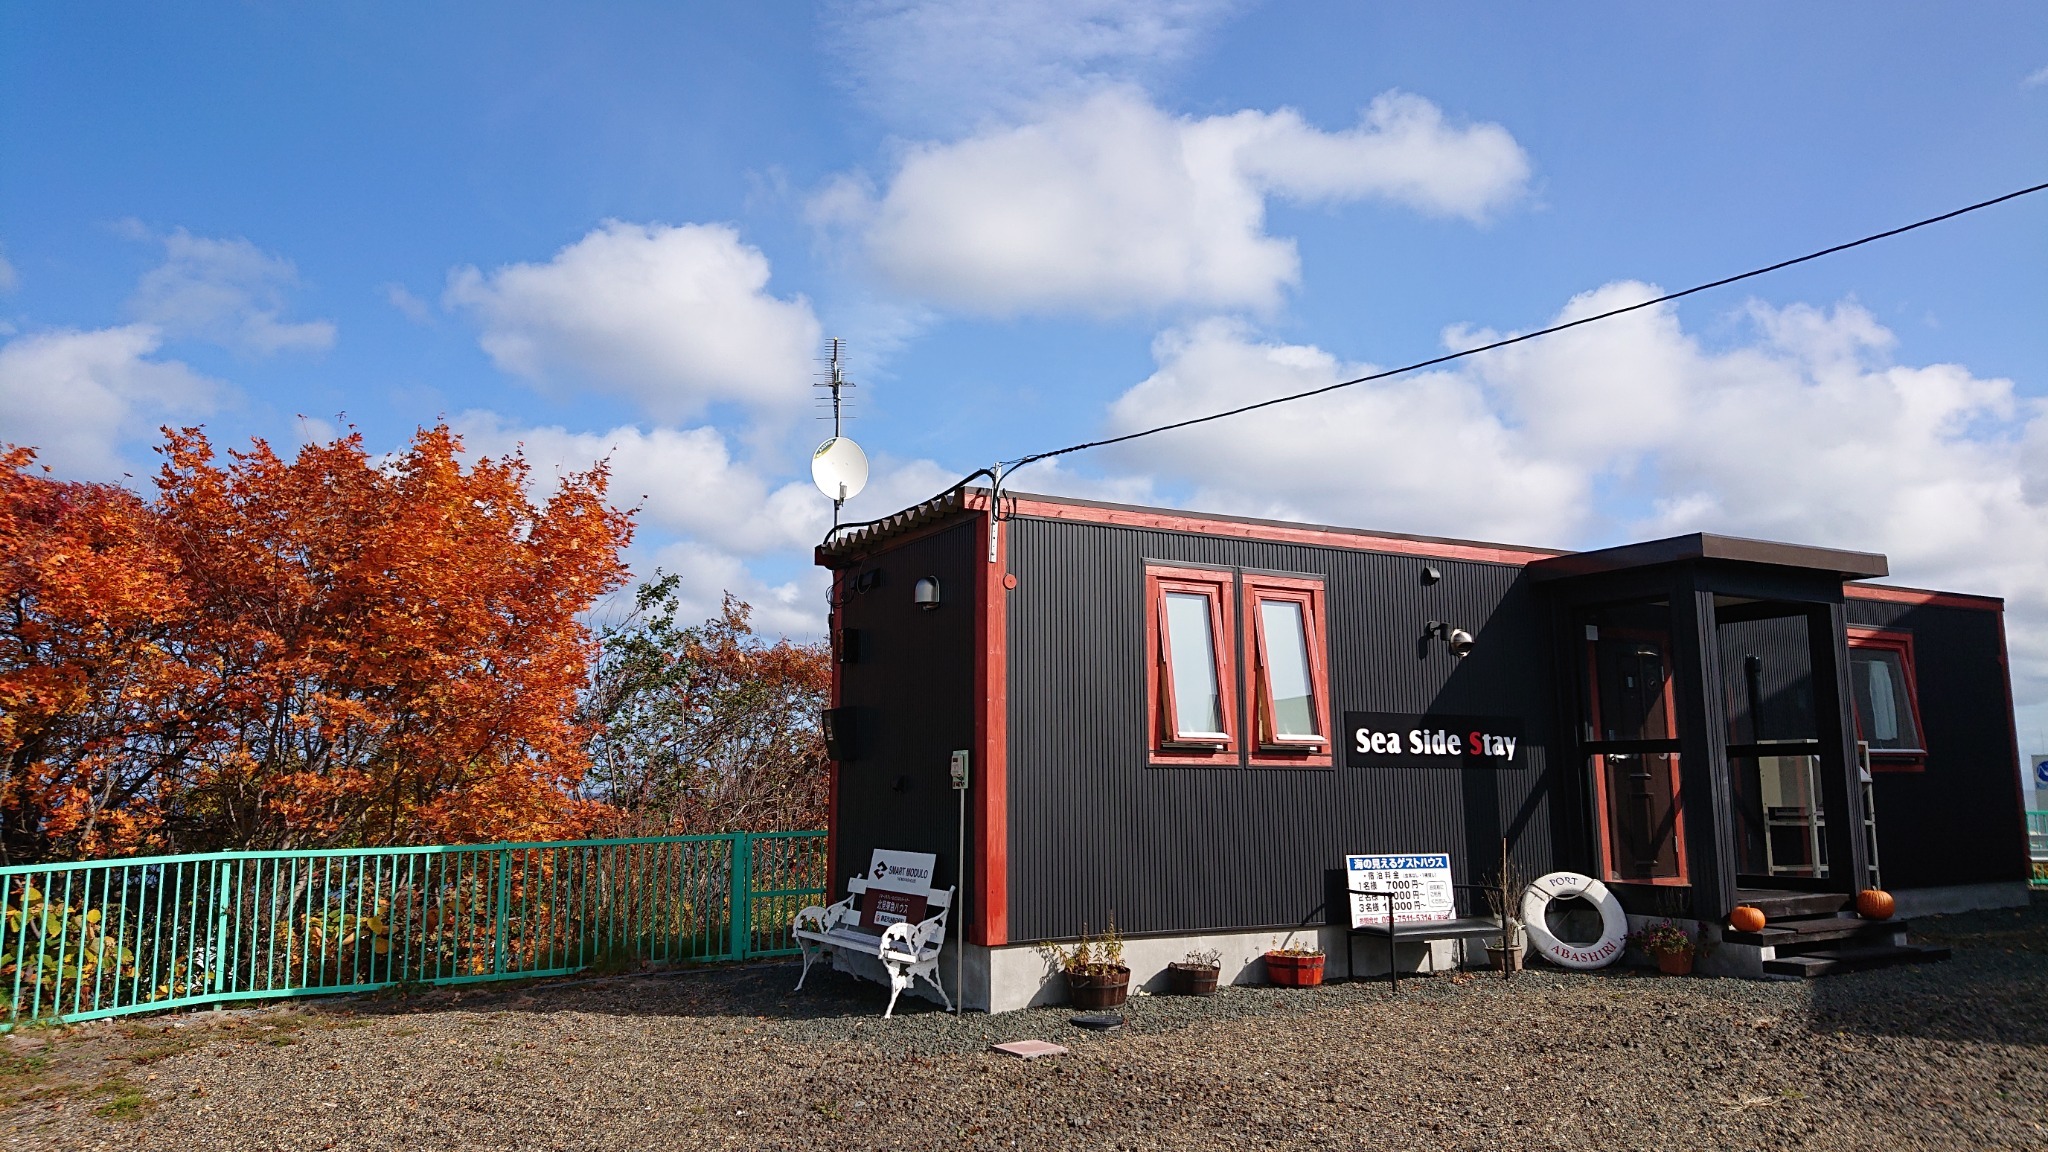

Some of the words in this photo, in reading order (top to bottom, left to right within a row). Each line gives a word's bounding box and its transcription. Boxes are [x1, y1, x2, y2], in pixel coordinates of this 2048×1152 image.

[1356, 728, 1401, 754] Sea
[1409, 729, 1461, 755] Side
[1469, 731, 1517, 761] Stay
[1354, 857, 1444, 870] 海の見えるゲストハウス
[888, 865, 906, 876] SMART
[906, 868, 929, 879] MODULO
[1359, 881, 1377, 890] 1名様
[1549, 877, 1578, 886] PORT
[1359, 903, 1379, 913] 3名様
[1551, 941, 1617, 962] ABASHIRI
